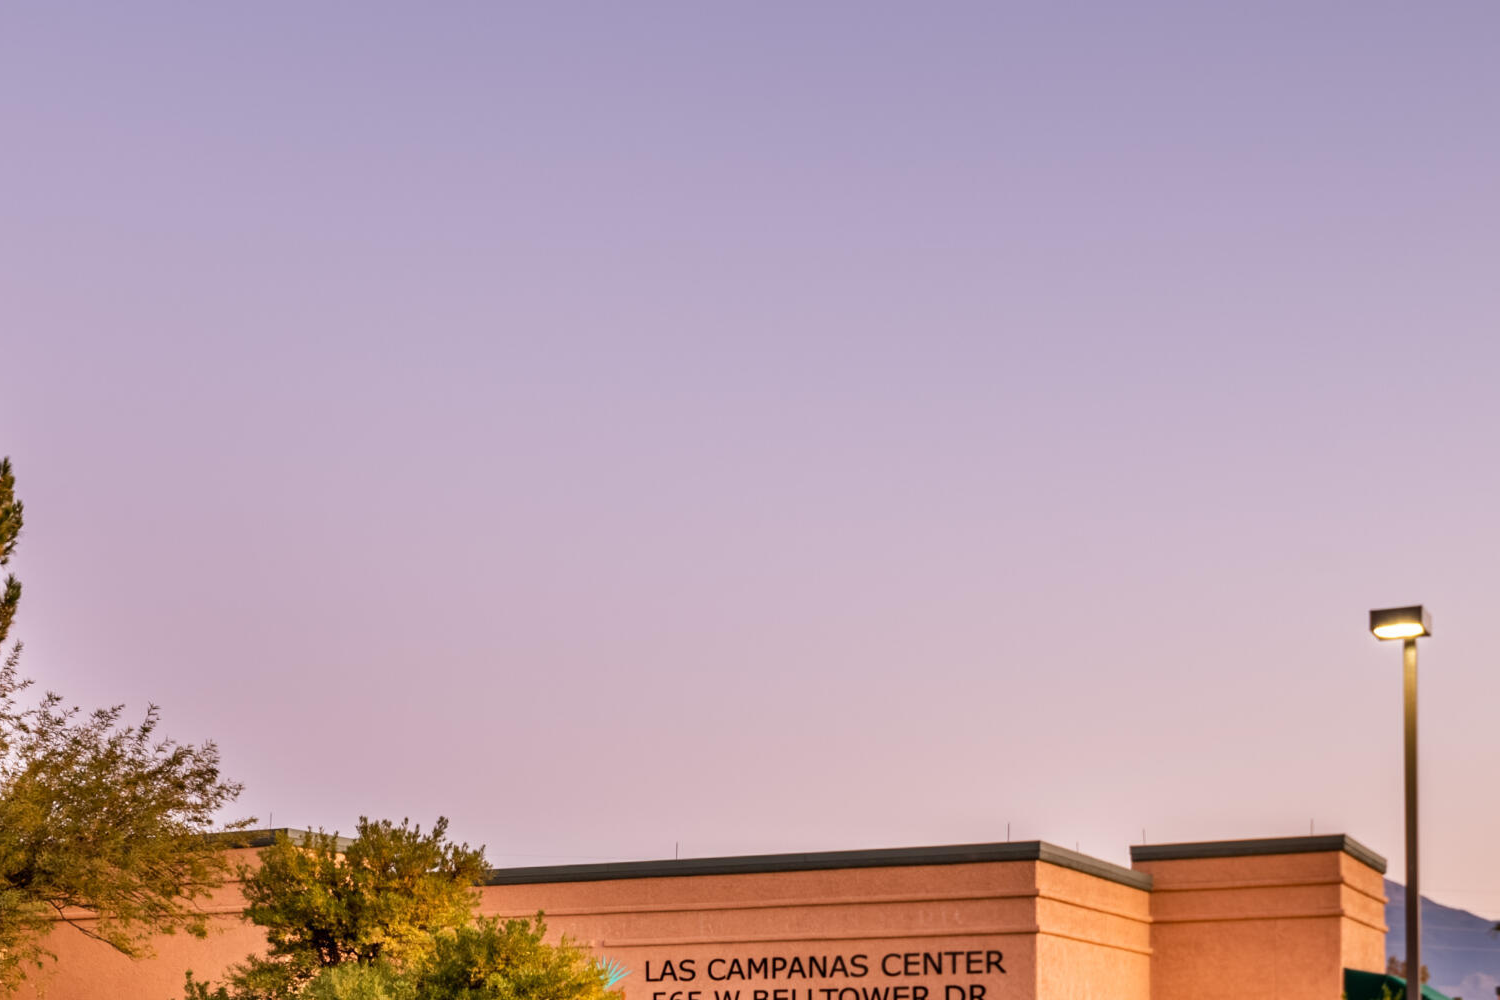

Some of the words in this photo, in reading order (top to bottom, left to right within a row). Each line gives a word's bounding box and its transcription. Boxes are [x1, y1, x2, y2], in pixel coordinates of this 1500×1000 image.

[644, 959, 697, 983] LAS
[707, 954, 869, 981] CAMPANAS
[881, 950, 1007, 976] CENTER
